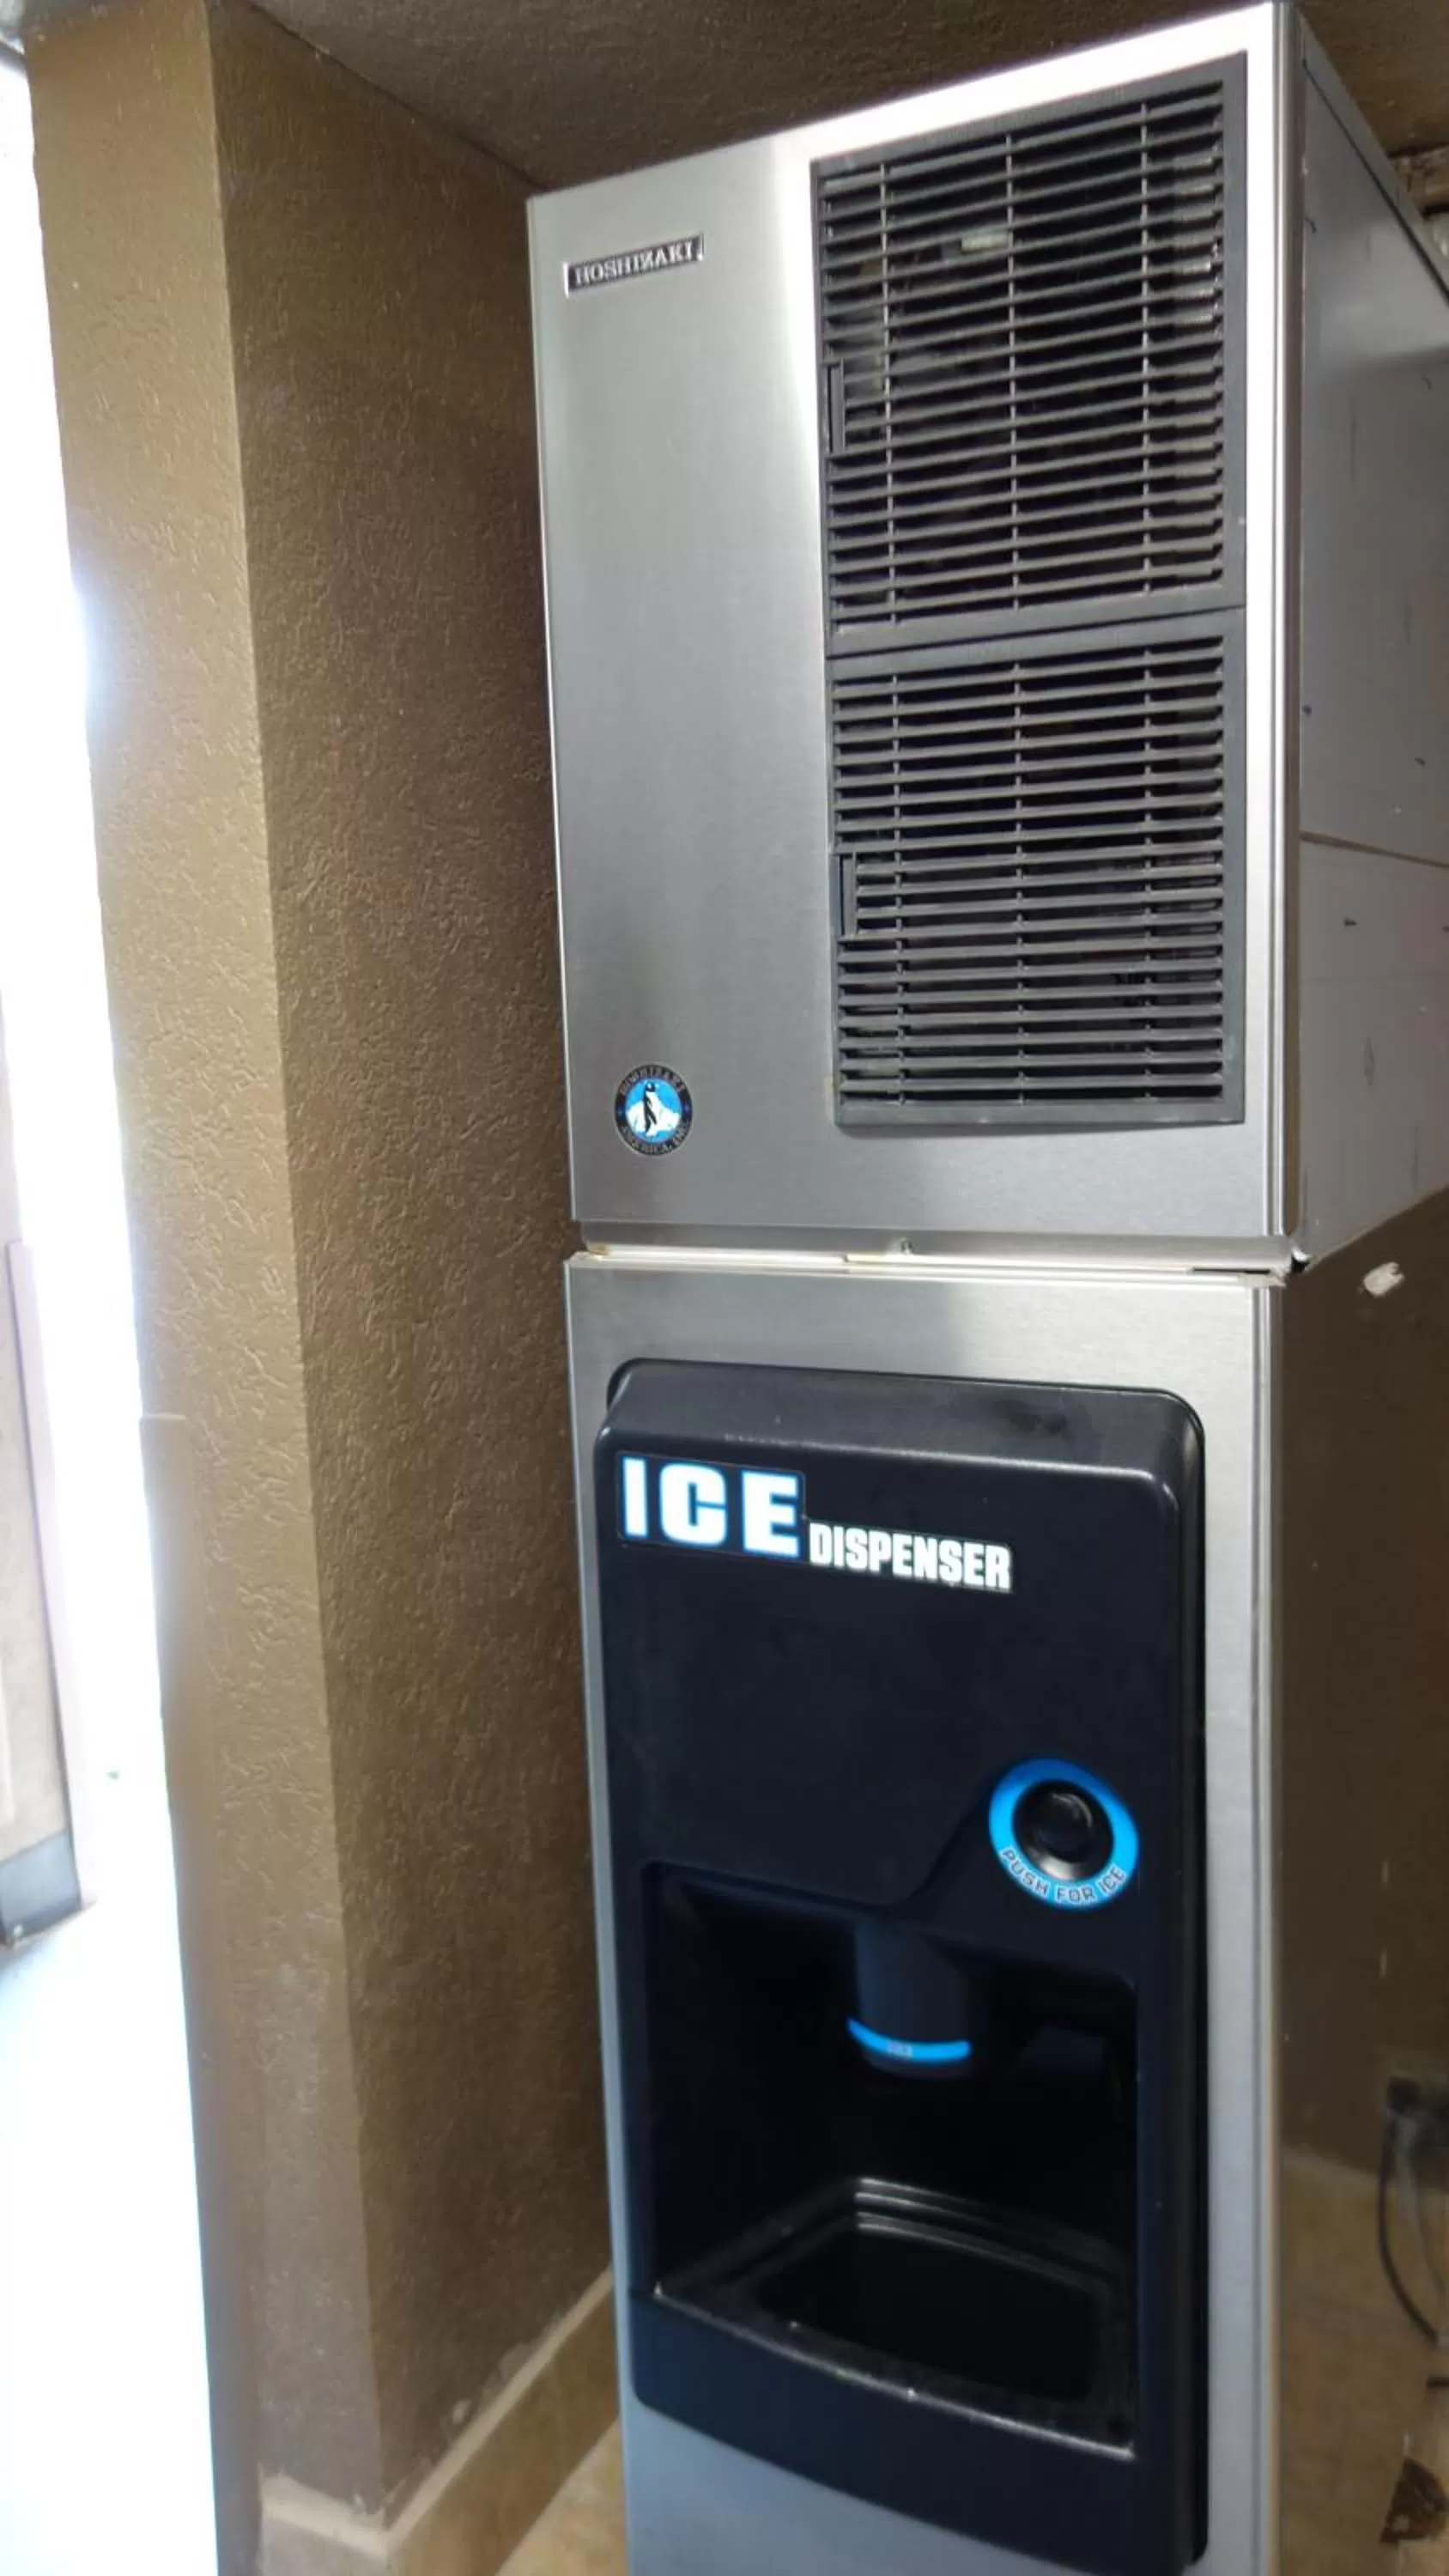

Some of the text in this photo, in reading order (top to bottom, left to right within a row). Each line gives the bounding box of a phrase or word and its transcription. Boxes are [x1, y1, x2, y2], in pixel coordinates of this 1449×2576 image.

[573, 240, 694, 286] HOSHIZAKI
[622, 1455, 1012, 1591] ICE DISPENSER
[1001, 1847, 1126, 1903] PUSH FOR ICE
